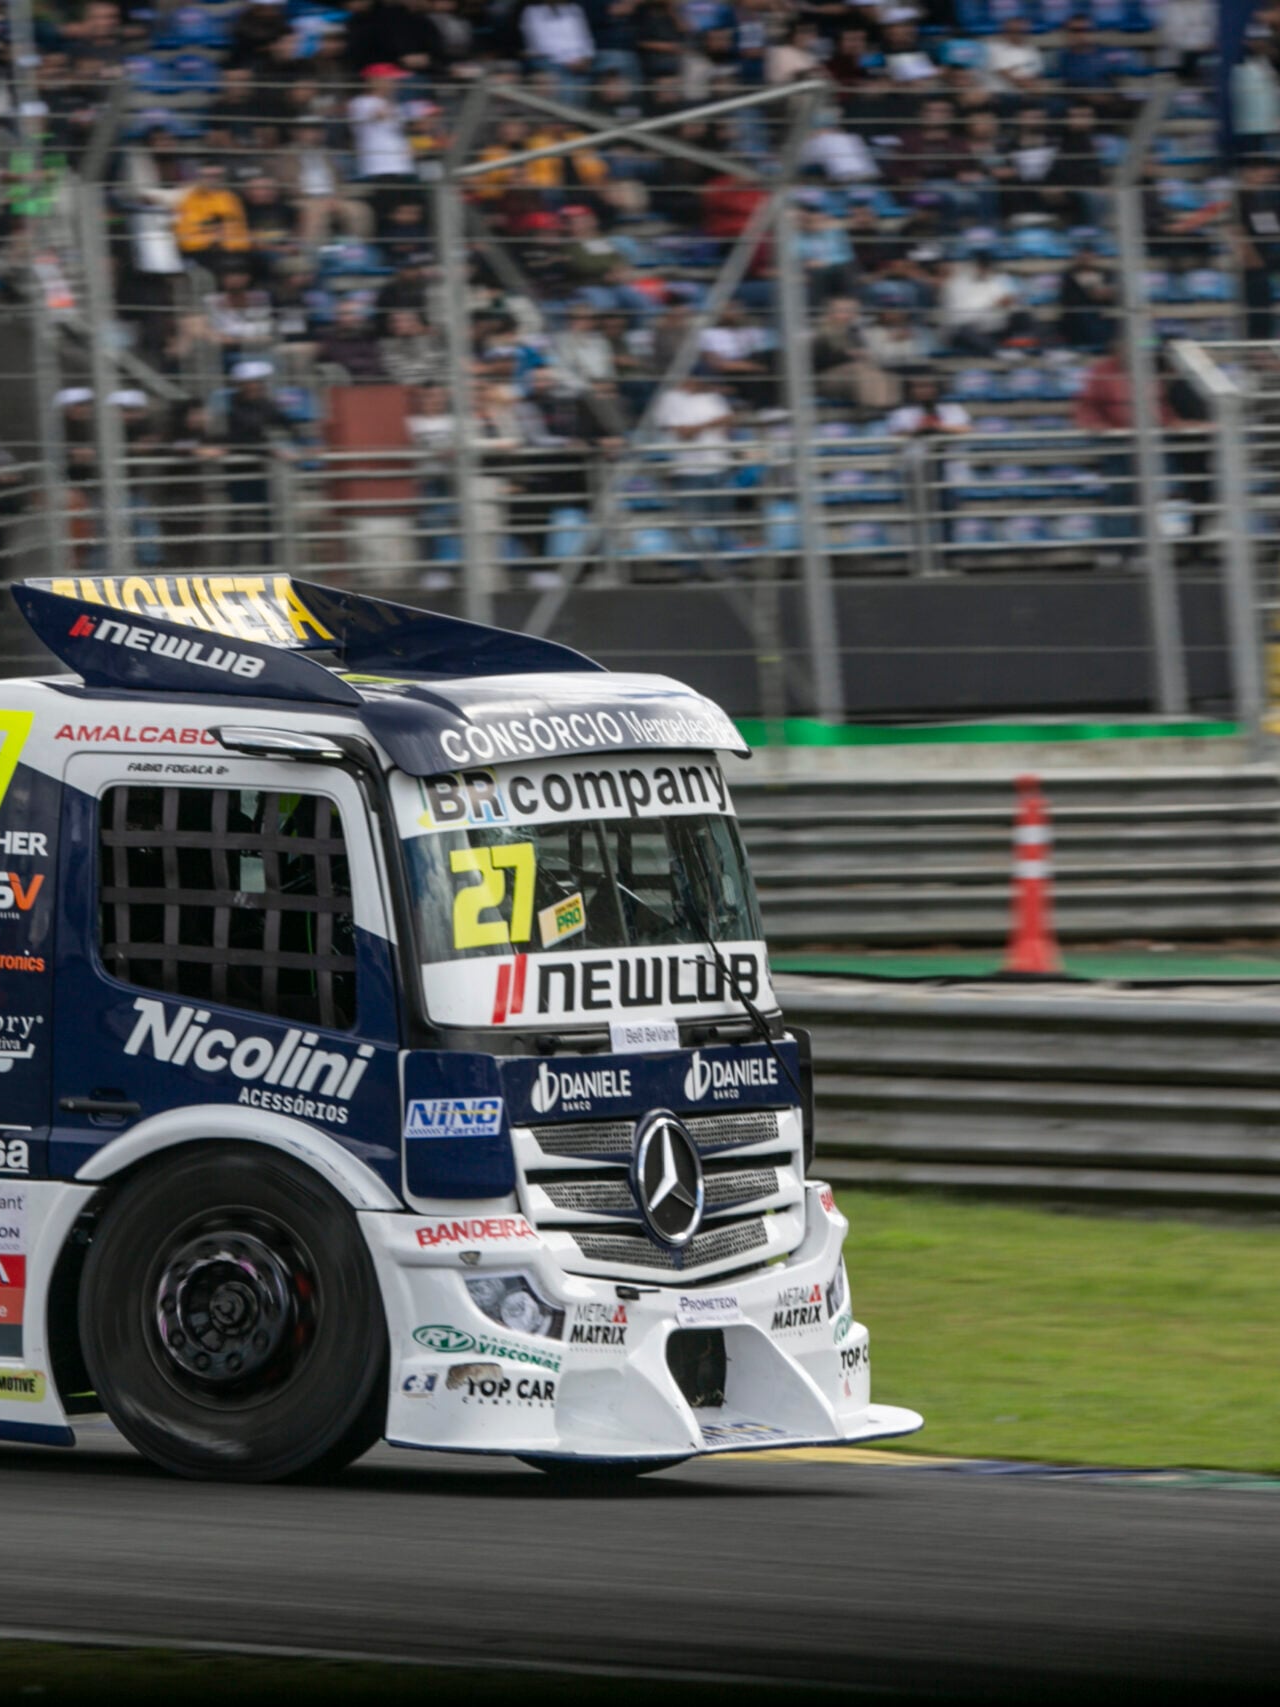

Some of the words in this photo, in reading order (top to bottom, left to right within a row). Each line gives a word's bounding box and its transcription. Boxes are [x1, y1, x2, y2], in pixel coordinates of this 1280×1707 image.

[52, 577, 335, 641] CHIETA
[94, 618, 267, 679] NEWLUB
[440, 707, 624, 764] CONSÓRCIO
[422, 769, 506, 823] BR
[508, 764, 728, 818] company
[450, 842, 536, 950] 27
[537, 953, 760, 1014] NEWLUB
[123, 997, 376, 1100] Nicolini
[560, 1069, 632, 1100] DANIELE
[712, 1058, 778, 1087] DANIELE
[237, 1086, 349, 1125] ACESSÓRIOS
[415, 1218, 540, 1247] BANDEIRA
[679, 1296, 738, 1312] PROMETEON
[771, 1304, 823, 1331] MATRIX
[420, 1327, 466, 1348] RV
[570, 1324, 628, 1346] MATRIX
[841, 1347, 861, 1371] TOP
[467, 1377, 511, 1398] TOP
[516, 1378, 556, 1401] CAR
